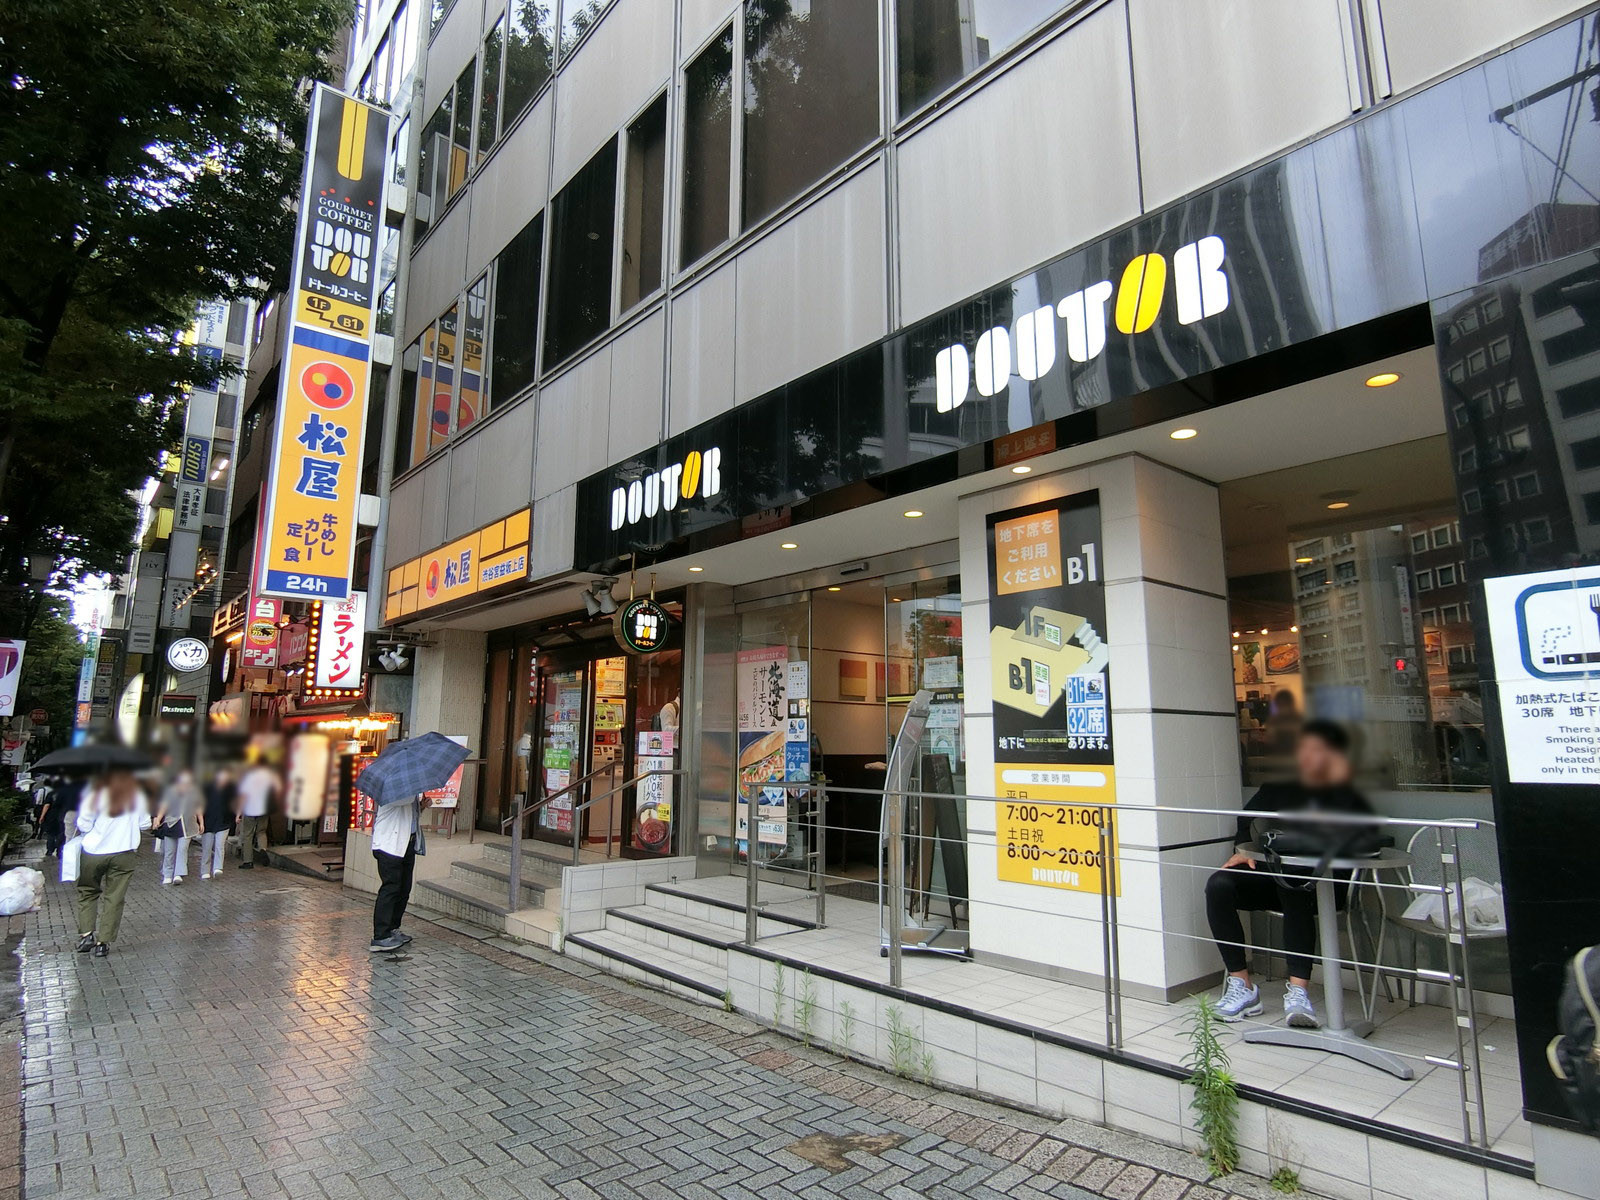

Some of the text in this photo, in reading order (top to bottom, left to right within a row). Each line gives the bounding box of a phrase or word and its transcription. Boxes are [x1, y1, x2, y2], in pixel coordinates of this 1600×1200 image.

[317, 205, 373, 233] COFFEE
[318, 196, 374, 221] GOURMET
[308, 277, 368, 302] ドトールコーヒー
[312, 299, 328, 310] 1F
[343, 317, 359, 330] B1
[935, 235, 1230, 414] DOUTOR
[294, 413, 348, 500] 松屋
[611, 447, 721, 531] DOUTOR
[284, 522, 303, 563] 定食
[304, 518, 320, 561] カレー
[321, 513, 338, 556] 牛めし
[999, 519, 1054, 543] 地下席を
[1008, 542, 1048, 563] ご利用
[1067, 543, 1097, 585] B1
[444, 548, 472, 589] 松屋
[482, 556, 525, 582] 渋谷宮益坂上店
[1003, 565, 1057, 585] ください
[286, 576, 328, 592] 24h
[1020, 606, 1045, 638] 1F
[245, 649, 261, 658] 2F
[328, 614, 355, 684] ラーメン
[1009, 657, 1033, 695] B1
[758, 666, 768, 728] サーモンと
[1516, 692, 1600, 705] 加熱式たばこ
[1522, 706, 1600, 718] 30席 地下
[998, 737, 1025, 750] 地下に
[1068, 737, 1109, 750] あります。
[1546, 736, 1594, 745] Smoking
[1541, 766, 1564, 775] only
[1555, 756, 1595, 764] Heated
[1031, 773, 1071, 784] 営業時間
[1007, 828, 1044, 843] 土日祝
